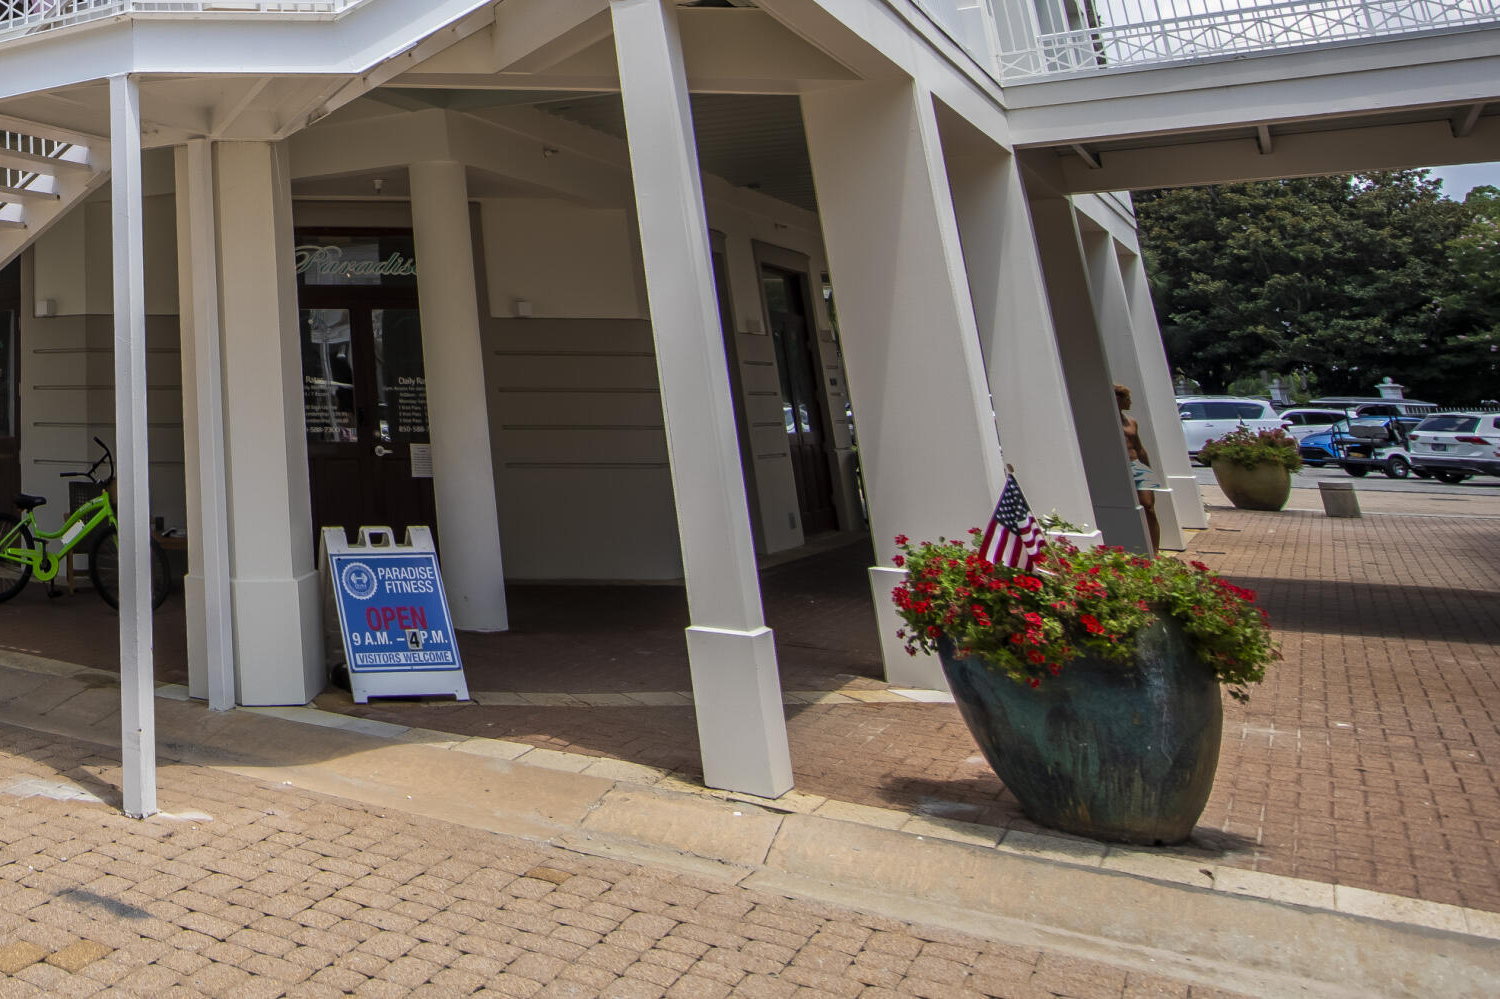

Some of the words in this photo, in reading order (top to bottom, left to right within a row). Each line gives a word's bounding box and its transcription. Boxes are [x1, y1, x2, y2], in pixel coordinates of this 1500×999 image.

[377, 566, 435, 580] PARADISE
[385, 580, 434, 593] FITNESS
[365, 605, 429, 631] OPEN
[352, 632, 362, 646] 9
[364, 631, 394, 646] A.M.
[409, 630, 421, 649] 4
[420, 630, 449, 644] P.M.
[358, 652, 401, 665] VISITORS
[402, 651, 451, 663] WELCOME
